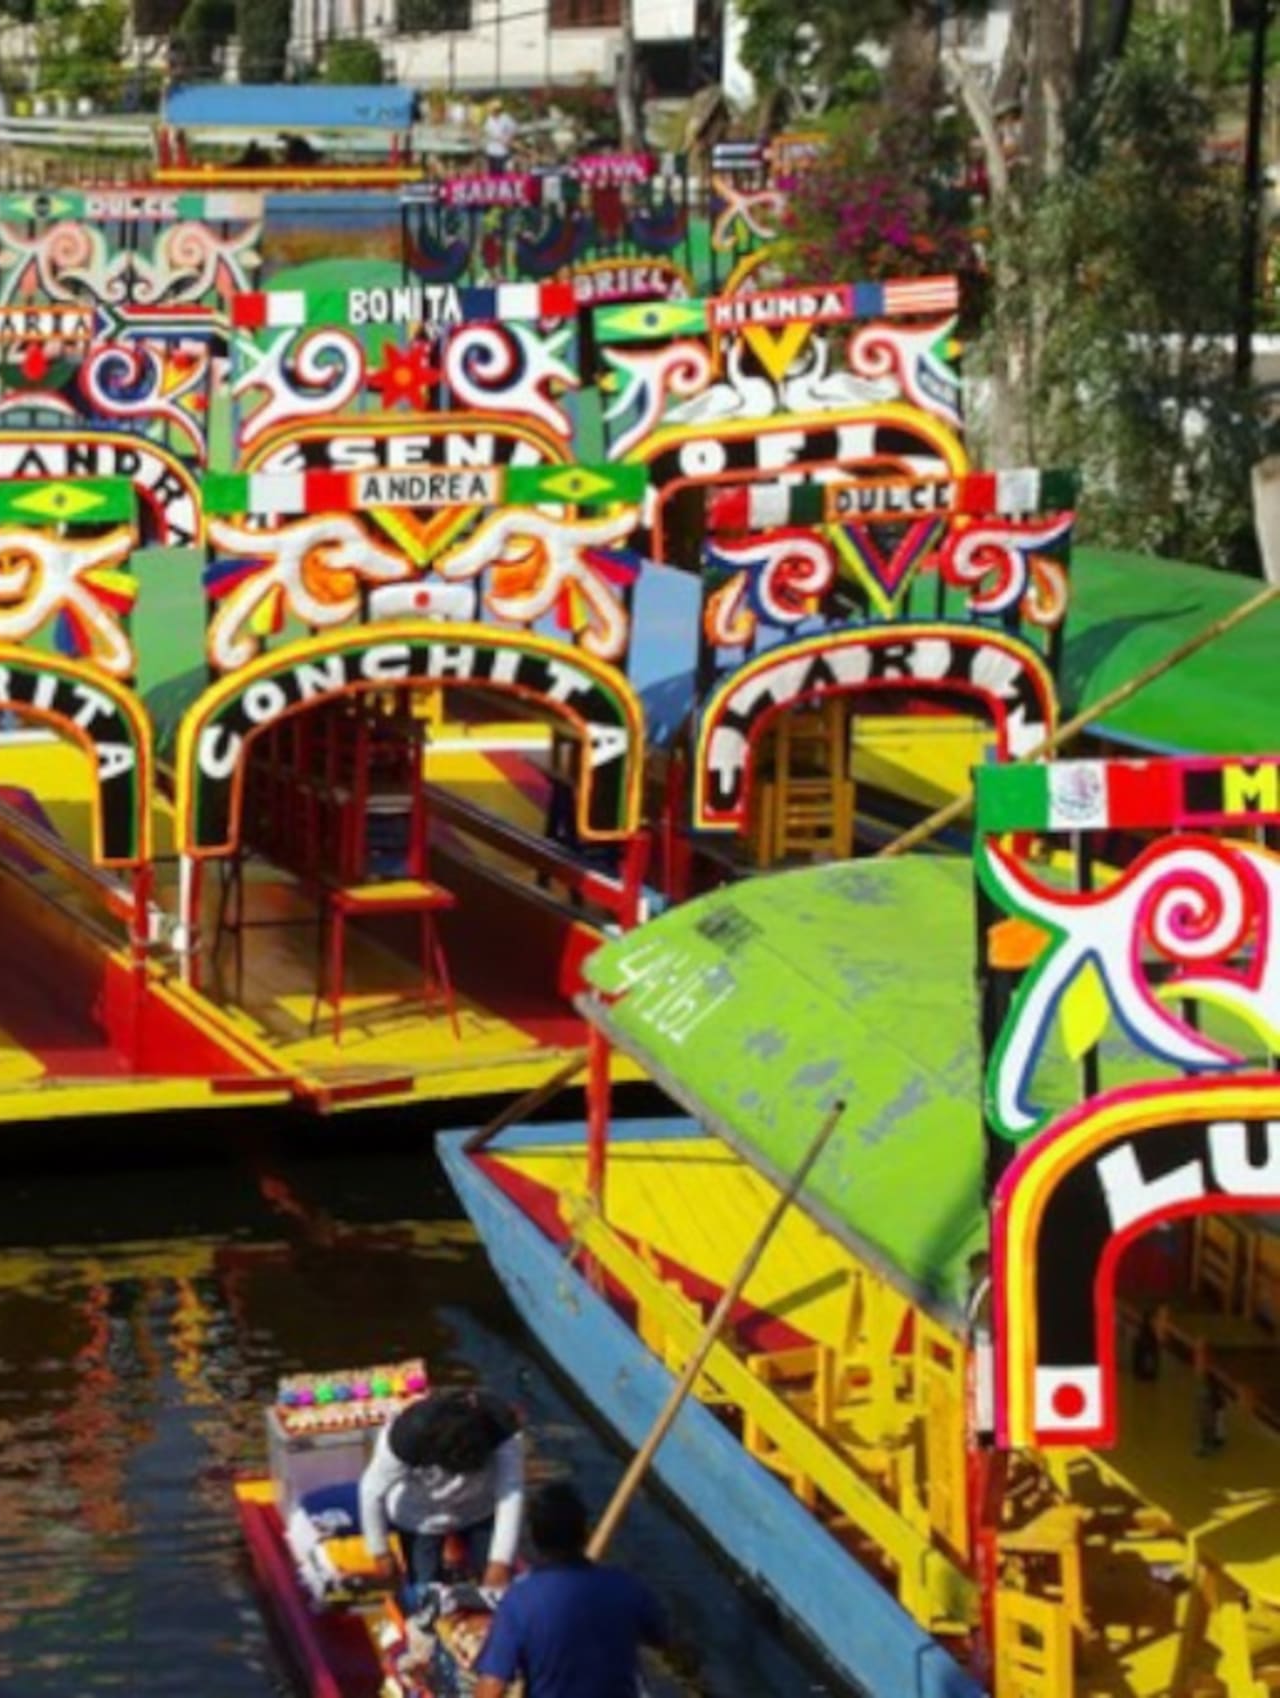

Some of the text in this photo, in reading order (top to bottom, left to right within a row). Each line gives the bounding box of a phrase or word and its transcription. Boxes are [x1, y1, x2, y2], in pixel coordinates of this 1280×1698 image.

[575, 269, 688, 300] BRIELA
[348, 287, 463, 325] BONITA
[363, 473, 489, 501] ANDREA
[835, 483, 952, 512] DULCE
[198, 644, 629, 779] CONCHITA
